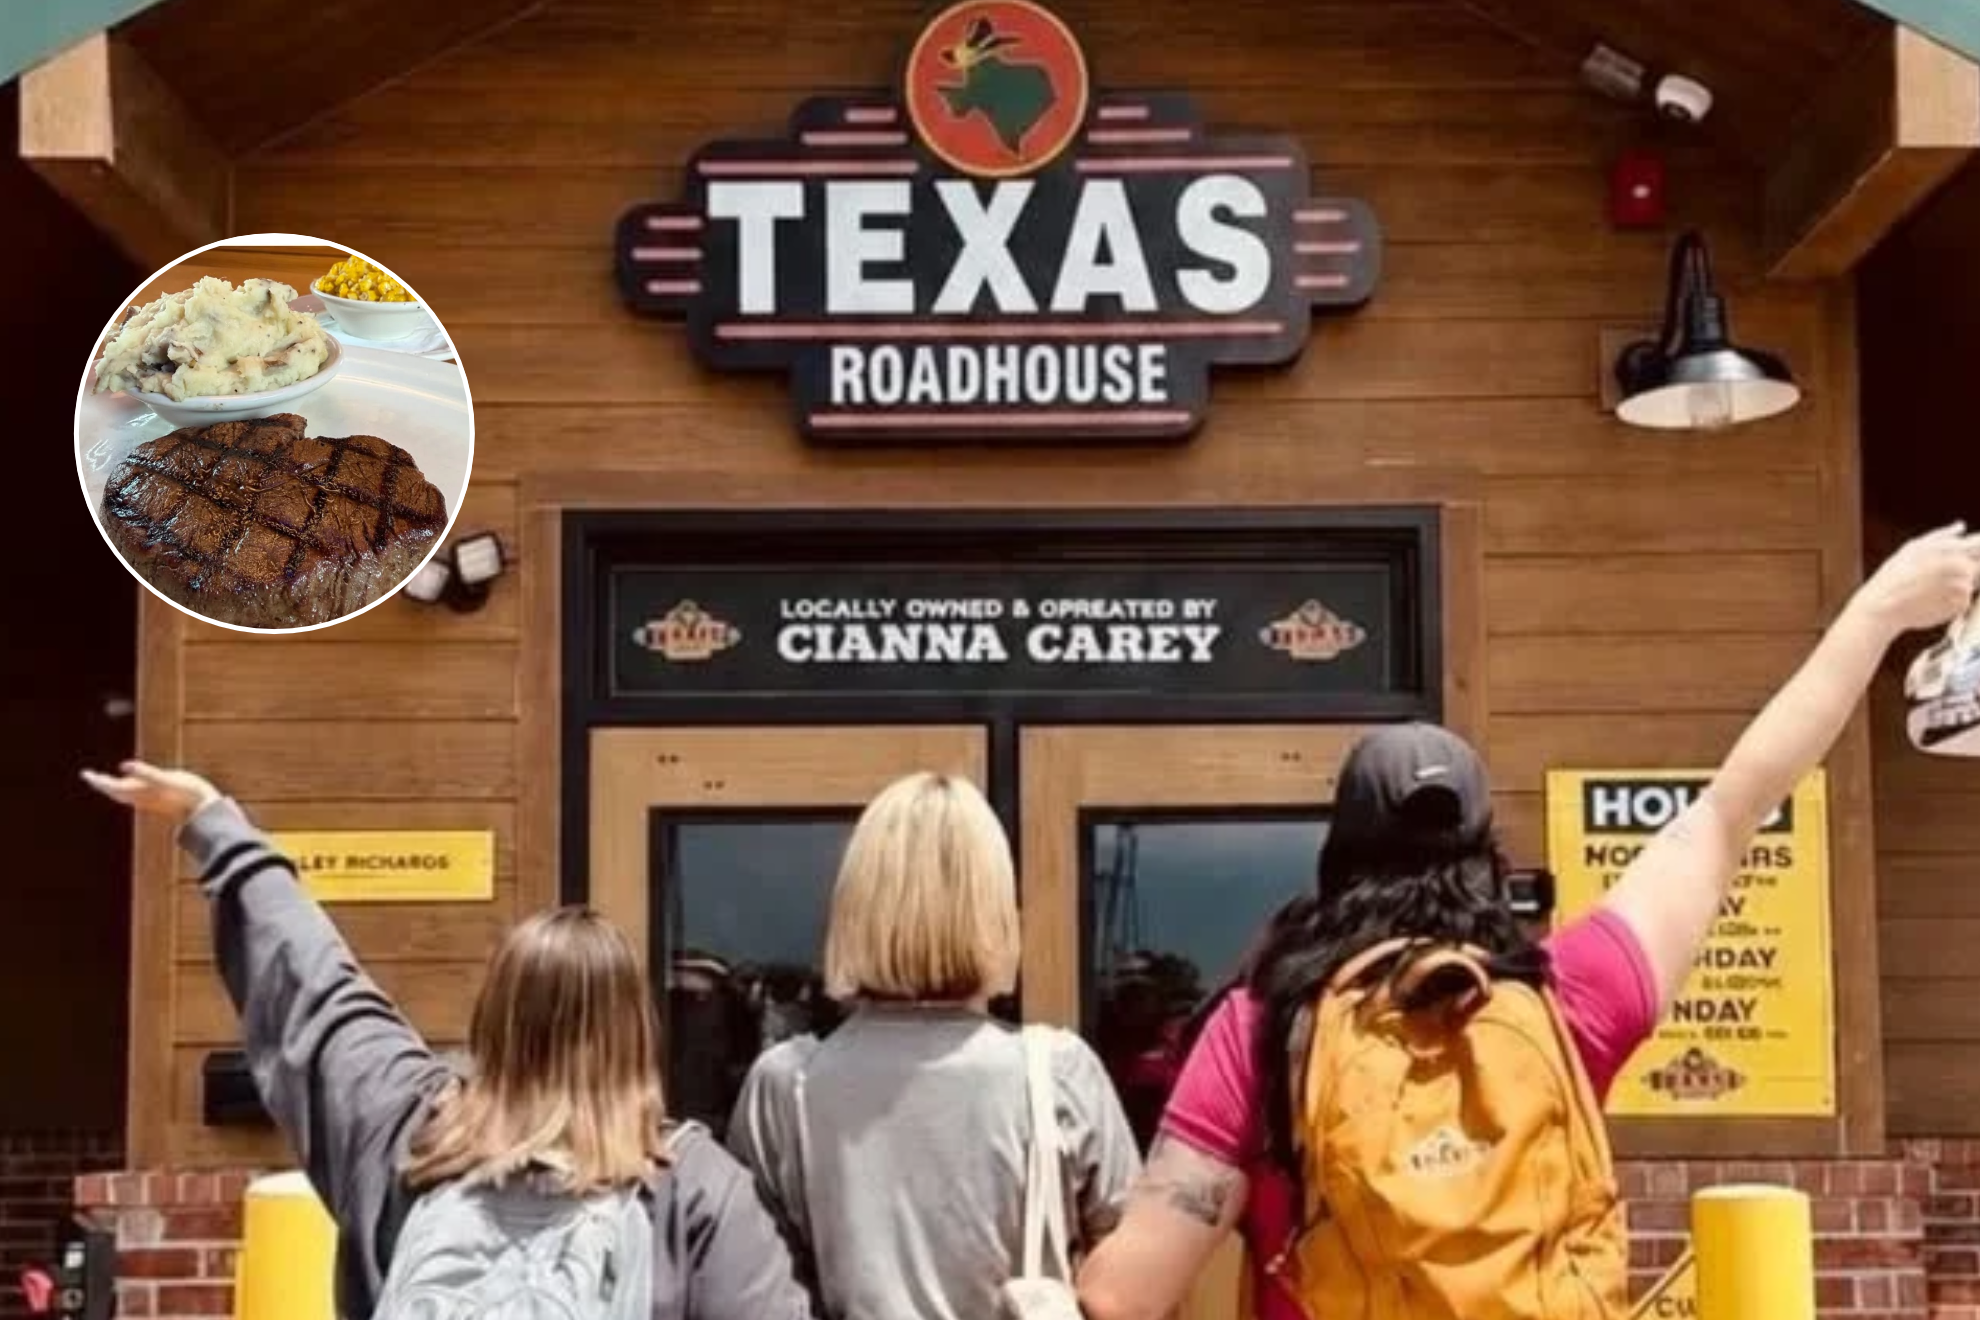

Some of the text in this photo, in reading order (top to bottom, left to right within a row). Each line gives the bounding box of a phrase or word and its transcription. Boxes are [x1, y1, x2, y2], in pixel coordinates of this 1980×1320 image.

[707, 174, 1272, 315] TEXAS
[831, 345, 1167, 404] ROADHOUSE
[780, 599, 896, 619] LOCALLY
[906, 599, 1004, 619] OWNED
[1184, 599, 1217, 619] BY
[777, 624, 1221, 662] CIANNA CAREY
[300, 855, 338, 870] LEY
[1673, 998, 1757, 1022] NDAY
